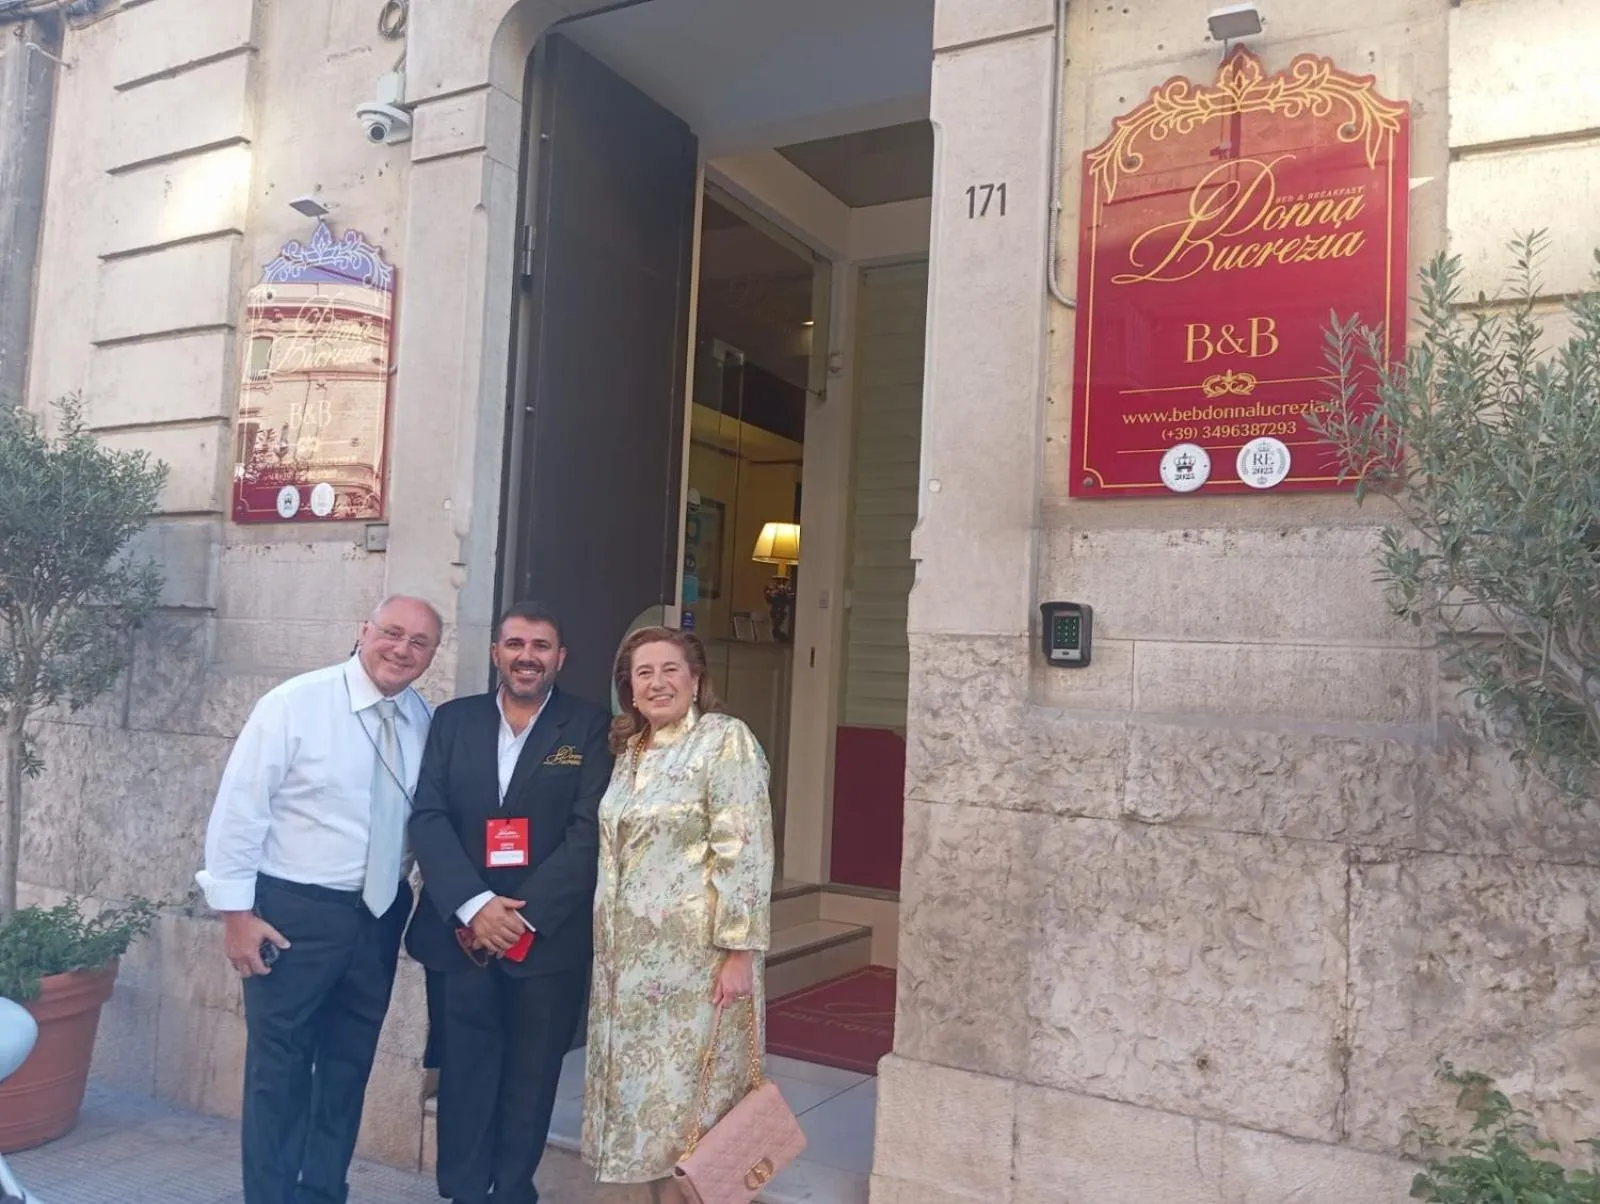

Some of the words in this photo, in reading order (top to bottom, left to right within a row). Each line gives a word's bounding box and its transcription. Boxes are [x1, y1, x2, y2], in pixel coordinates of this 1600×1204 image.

[965, 182, 1007, 219] 171
[1190, 154, 1366, 237] Donna
[1307, 184, 1366, 201] BREAKFAST
[1110, 180, 1366, 284] Lucrezia
[1183, 316, 1280, 363] B&B
[289, 399, 333, 429] B&B
[1161, 426, 1199, 441] (+39)
[1202, 421, 1297, 439] 3496387293
[1252, 452, 1275, 466] RE
